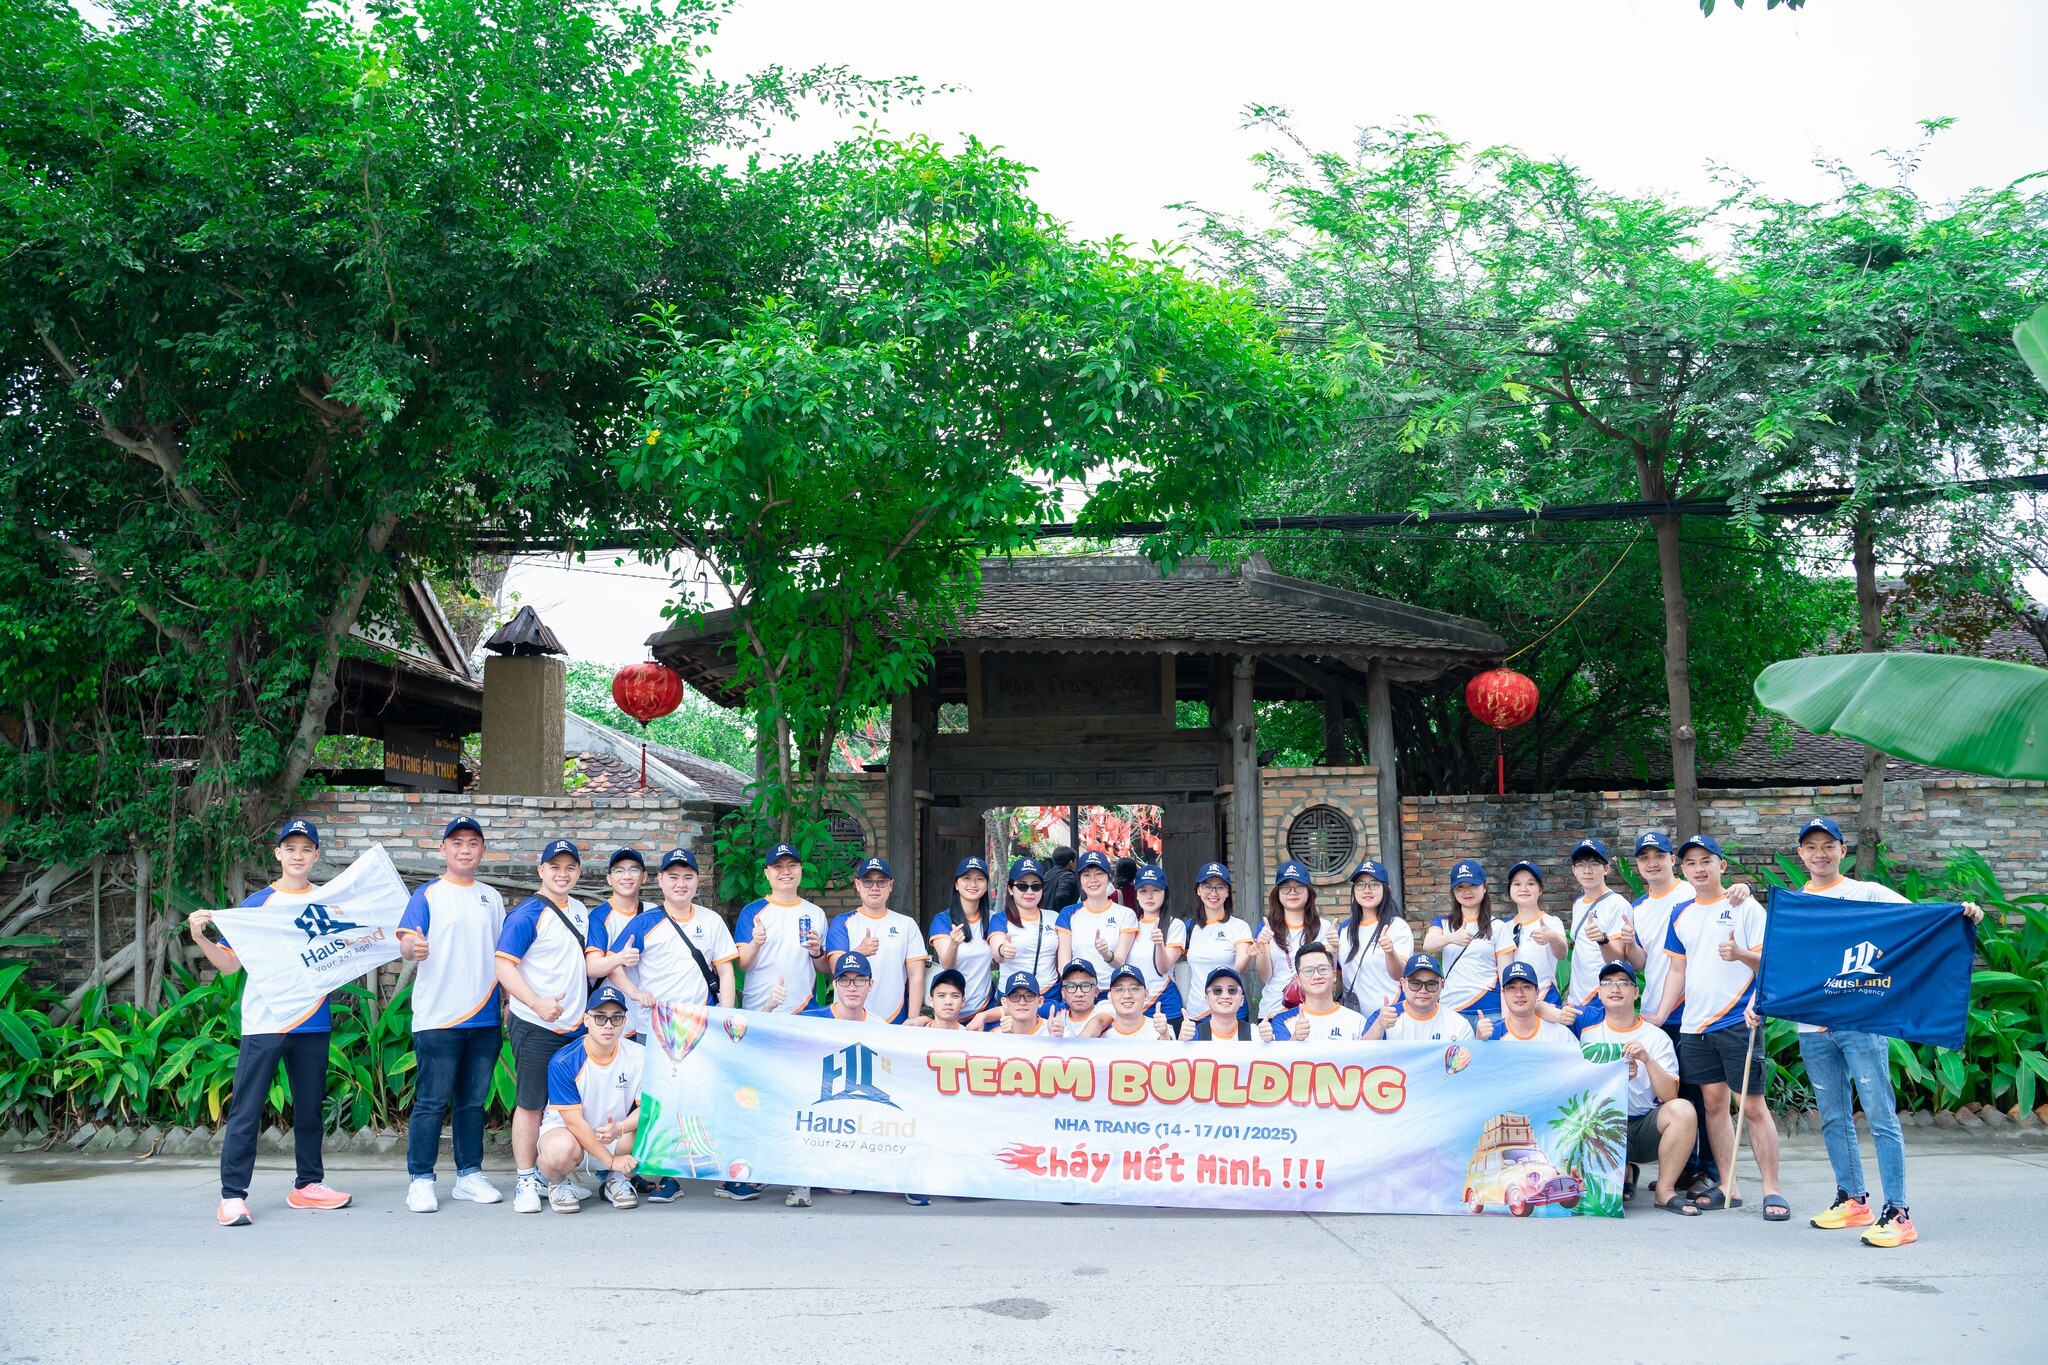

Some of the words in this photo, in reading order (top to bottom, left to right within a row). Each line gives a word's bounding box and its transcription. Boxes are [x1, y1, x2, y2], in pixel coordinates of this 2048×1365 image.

[300, 926, 385, 968] HausLand
[315, 960, 336, 973] Your
[1823, 976, 1892, 989] HausLand
[1858, 988, 1885, 997] Agency
[927, 1050, 1095, 1101] TEAM
[1109, 1059, 1406, 1114] BUILDING
[795, 1110, 917, 1138] HausLand
[1054, 1118, 1090, 1132] NHA
[1094, 1119, 1151, 1135] TRANG
[803, 1137, 830, 1148] Your
[835, 1139, 856, 1150] 247
[860, 1141, 907, 1155] Agency
[993, 1142, 1110, 1183] Cháy
[1123, 1143, 1185, 1182] Hết
[1197, 1153, 1272, 1187] Mình
